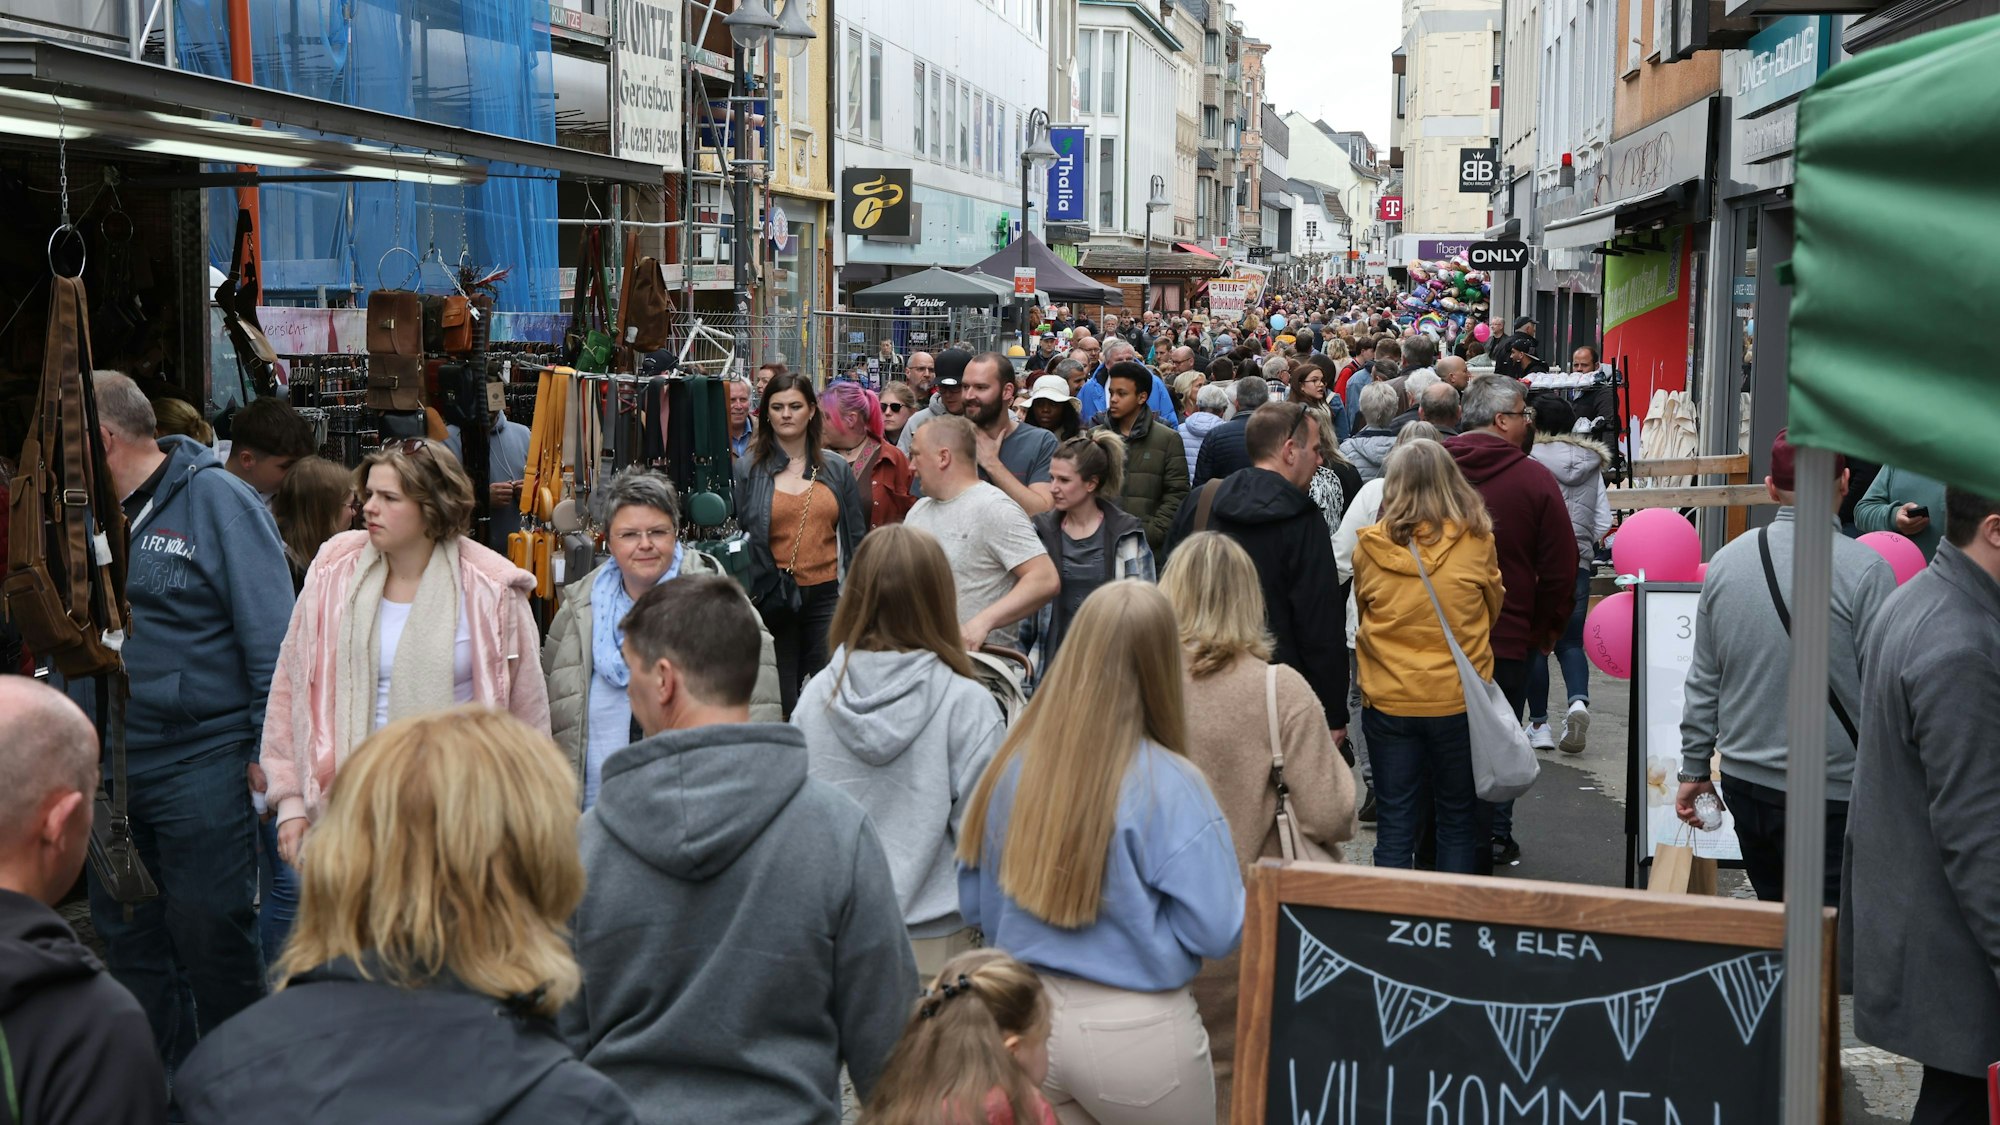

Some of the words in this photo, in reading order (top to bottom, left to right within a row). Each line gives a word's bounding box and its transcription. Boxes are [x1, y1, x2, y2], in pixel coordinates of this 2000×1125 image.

[551, 6, 580, 28] KUNTZE
[620, 0, 673, 61] KUNTZE
[1058, 153, 1073, 211] Thalia
[1436, 242, 1469, 255] liberty
[1471, 249, 1525, 263] ONLY
[1218, 283, 1237, 292] HIER
[914, 298, 947, 308] Tchibo
[1387, 920, 1452, 949] ZOE
[1478, 926, 1496, 958] &
[1517, 931, 1603, 962] ELEA
